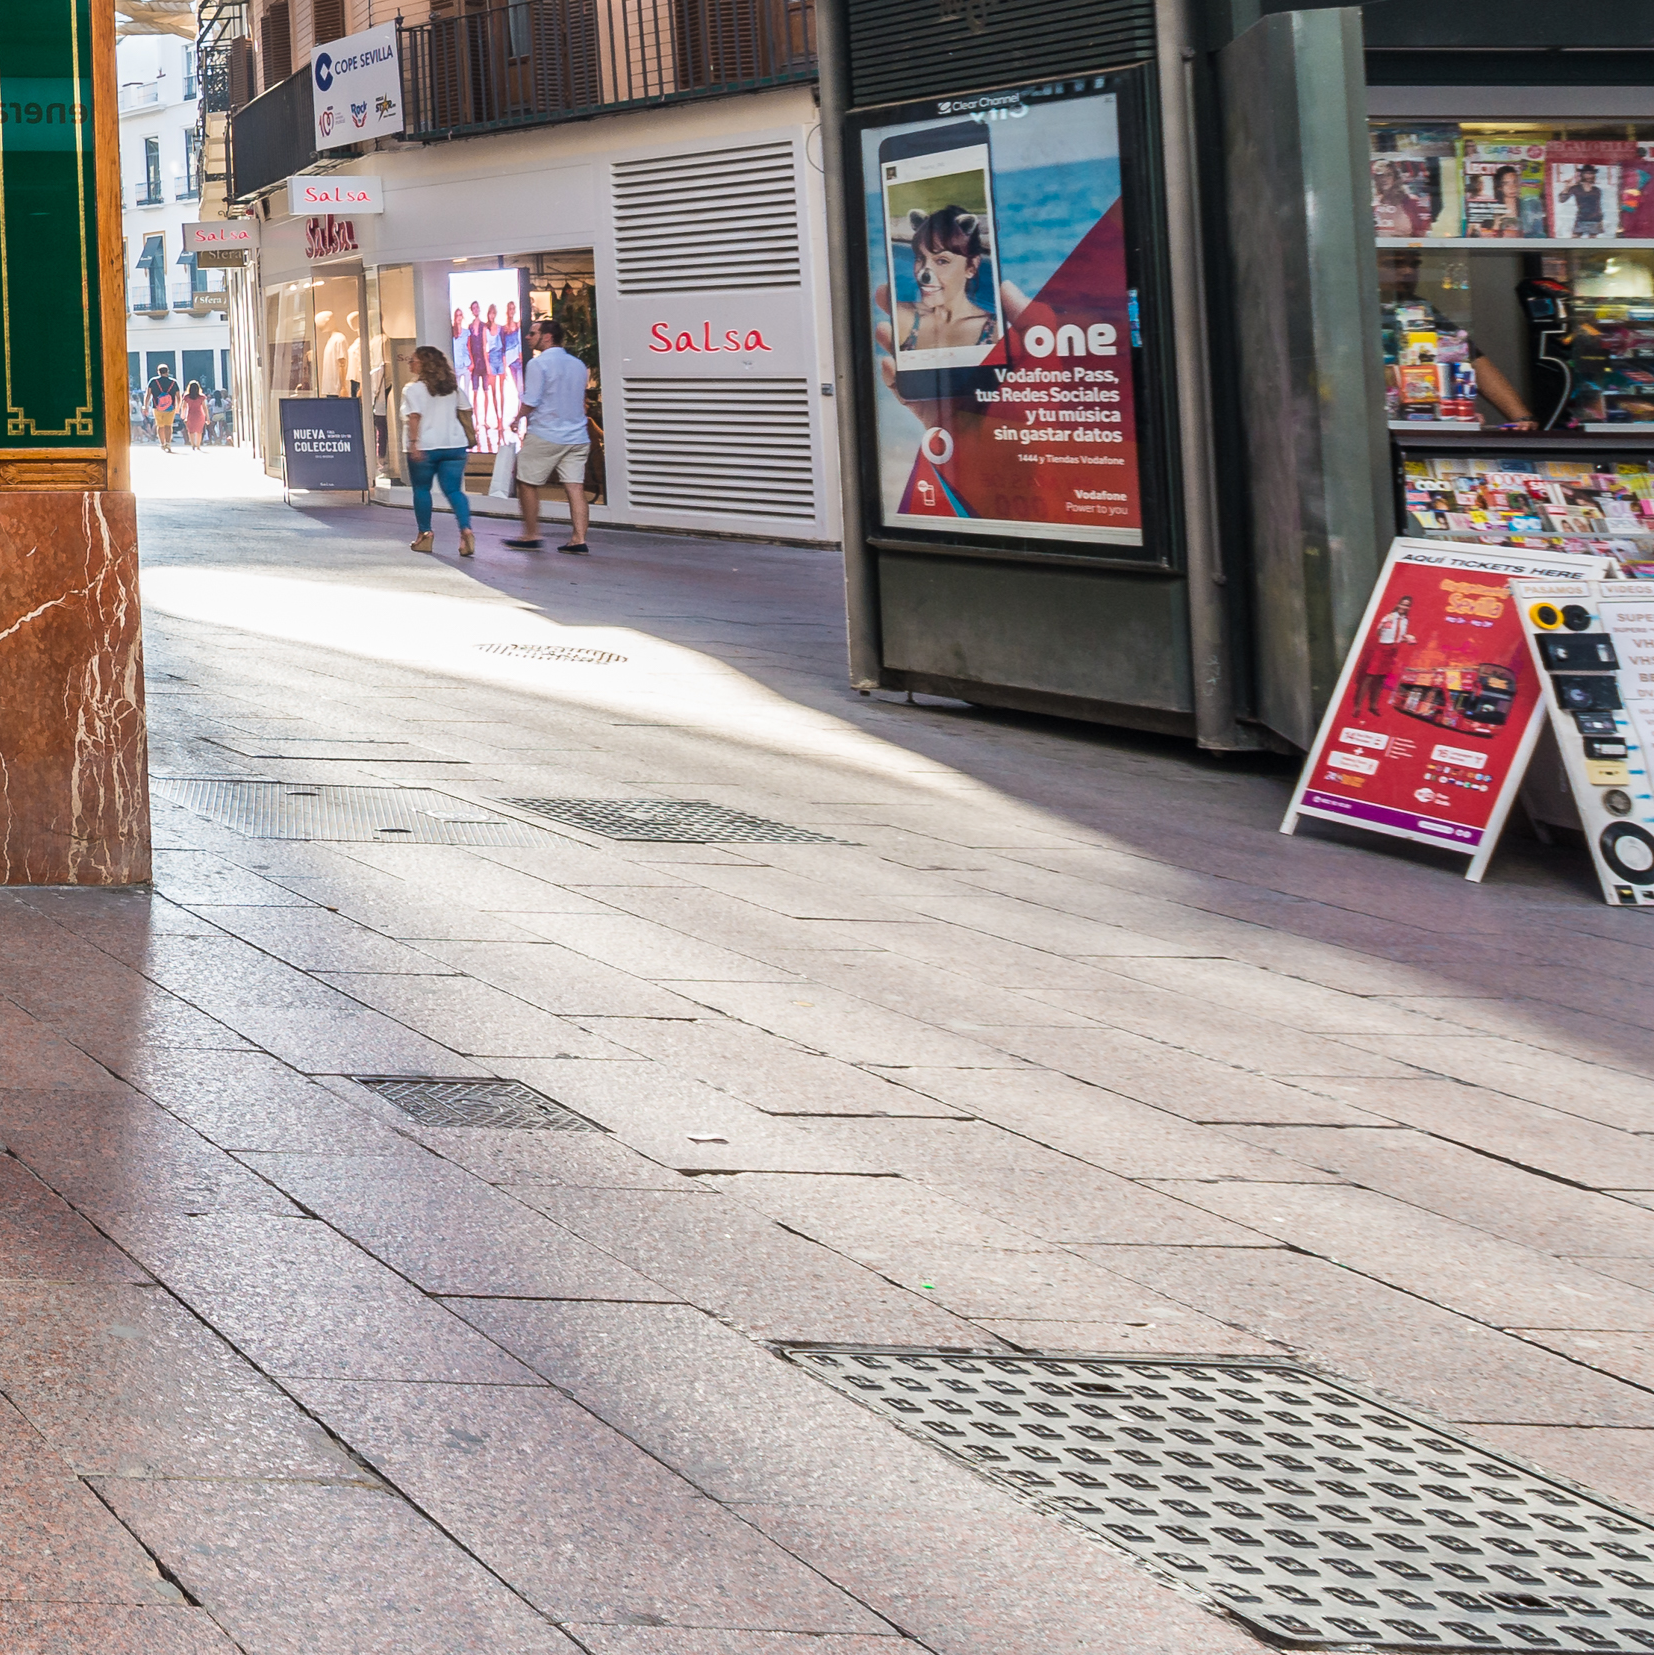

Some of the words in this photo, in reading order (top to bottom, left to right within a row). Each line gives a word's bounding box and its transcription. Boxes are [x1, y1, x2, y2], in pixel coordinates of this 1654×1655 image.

[334, 55, 358, 75] COPE
[359, 44, 394, 68] SEVILLA
[952, 100, 979, 112] Clear
[979, 92, 1020, 108] Channel
[304, 186, 372, 203] Salsa
[194, 228, 252, 243] Salsa
[304, 214, 359, 260] Salsa
[648, 320, 773, 354] Salsa
[1024, 323, 1117, 358] one
[994, 368, 1072, 384] Vodafone
[1073, 367, 1120, 385] Pass,
[976, 388, 1001, 402] tus
[1001, 387, 1049, 402] Redes
[1050, 386, 1121, 403] Sociales
[1025, 410, 1037, 425] y
[1038, 408, 1056, 423] tu
[1058, 406, 1122, 423] música
[293, 429, 326, 440] NUEVA
[994, 425, 1018, 440] sin
[1019, 428, 1072, 445] gastar
[1073, 427, 1123, 443] datos
[294, 440, 352, 453] COLECCIÓN
[1080, 455, 1125, 466] Vodafone
[1073, 489, 1128, 502] Vodafone
[1065, 501, 1096, 513] Power
[1096, 504, 1108, 514] to
[1108, 506, 1129, 517] you
[1449, 558, 1526, 574] TICKETS
[1529, 567, 1585, 580] HERE
[1524, 586, 1583, 595] PASAMOS
[1605, 584, 1653, 594] VIDEOS
